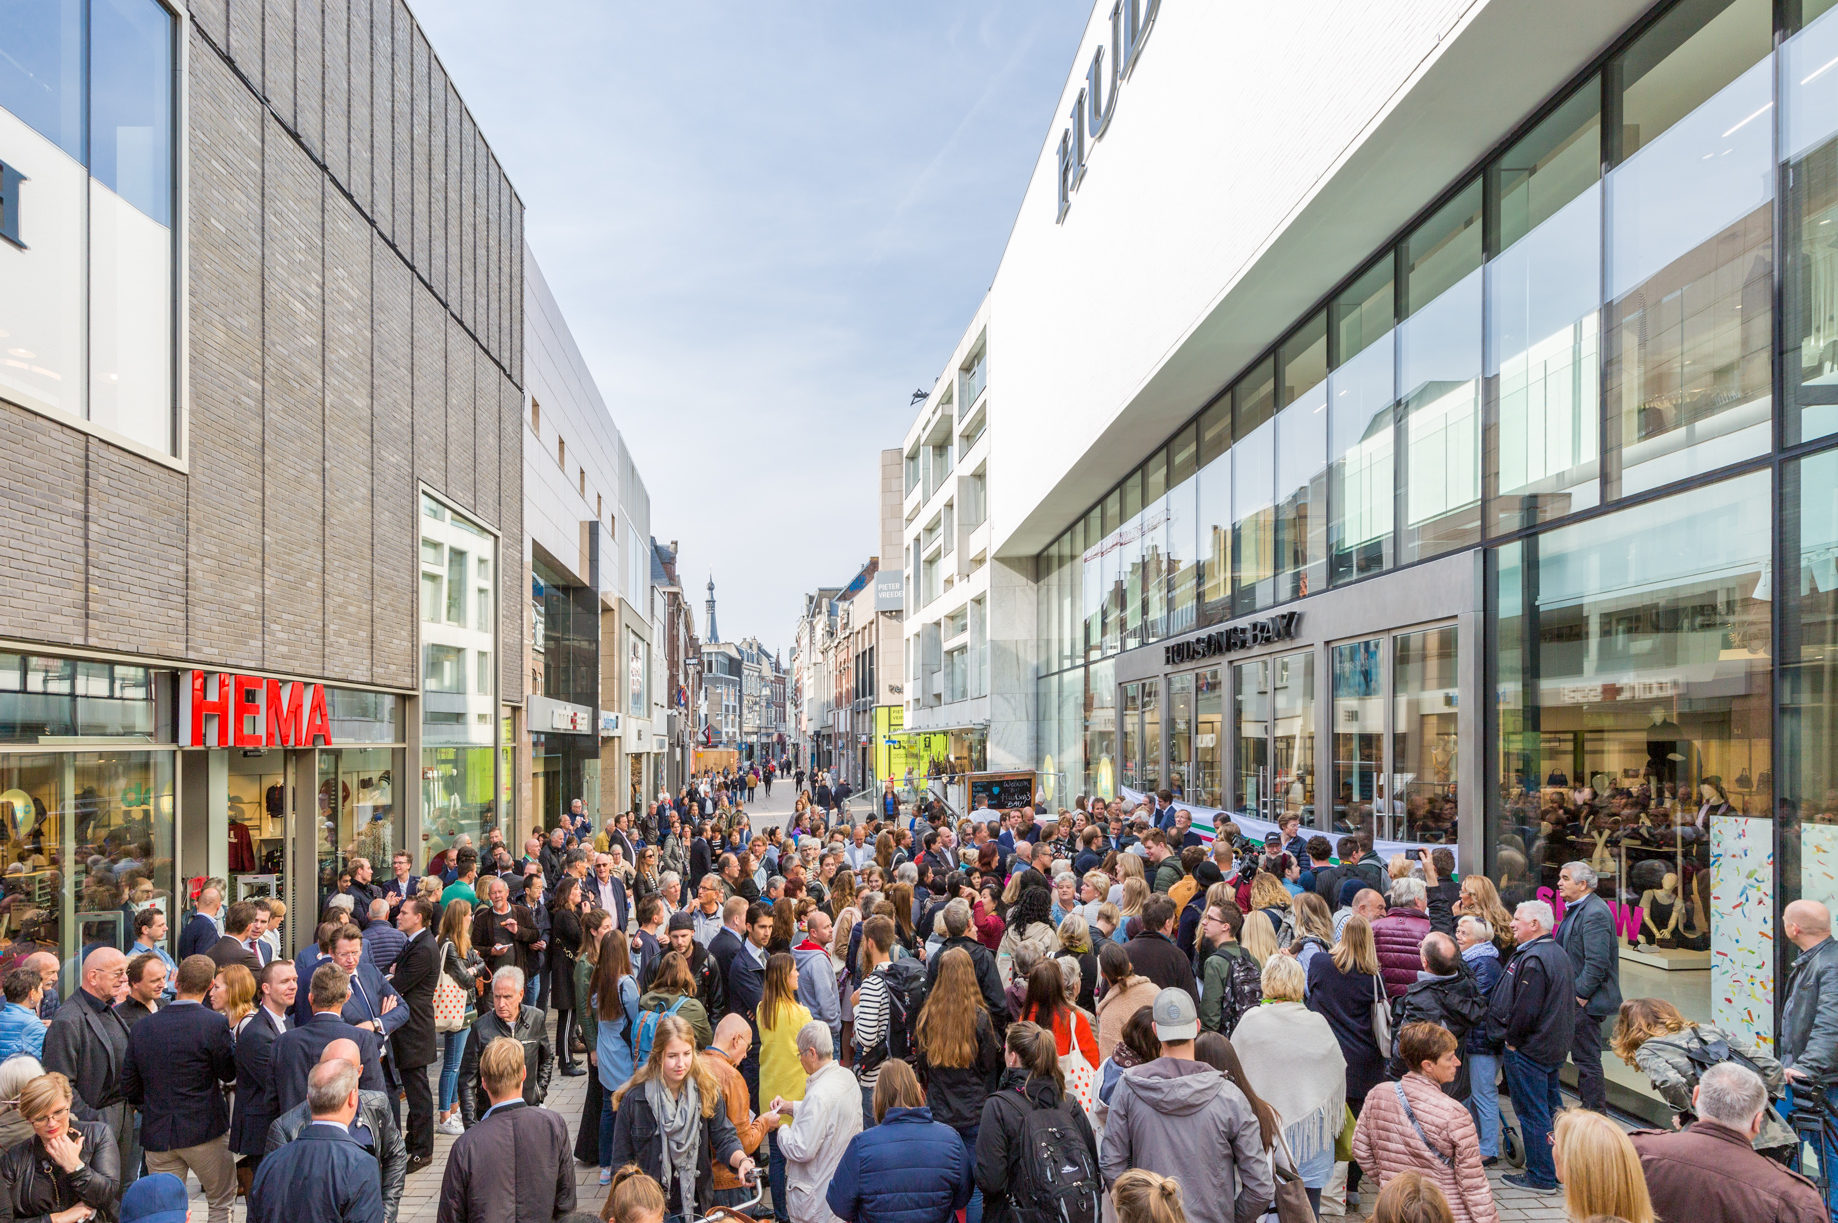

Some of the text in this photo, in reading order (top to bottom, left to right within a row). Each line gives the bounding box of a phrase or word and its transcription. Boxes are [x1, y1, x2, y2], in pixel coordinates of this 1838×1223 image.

[878, 582, 900, 591] PIETER
[1247, 610, 1298, 648] BAY
[180, 670, 333, 748] HEMA
